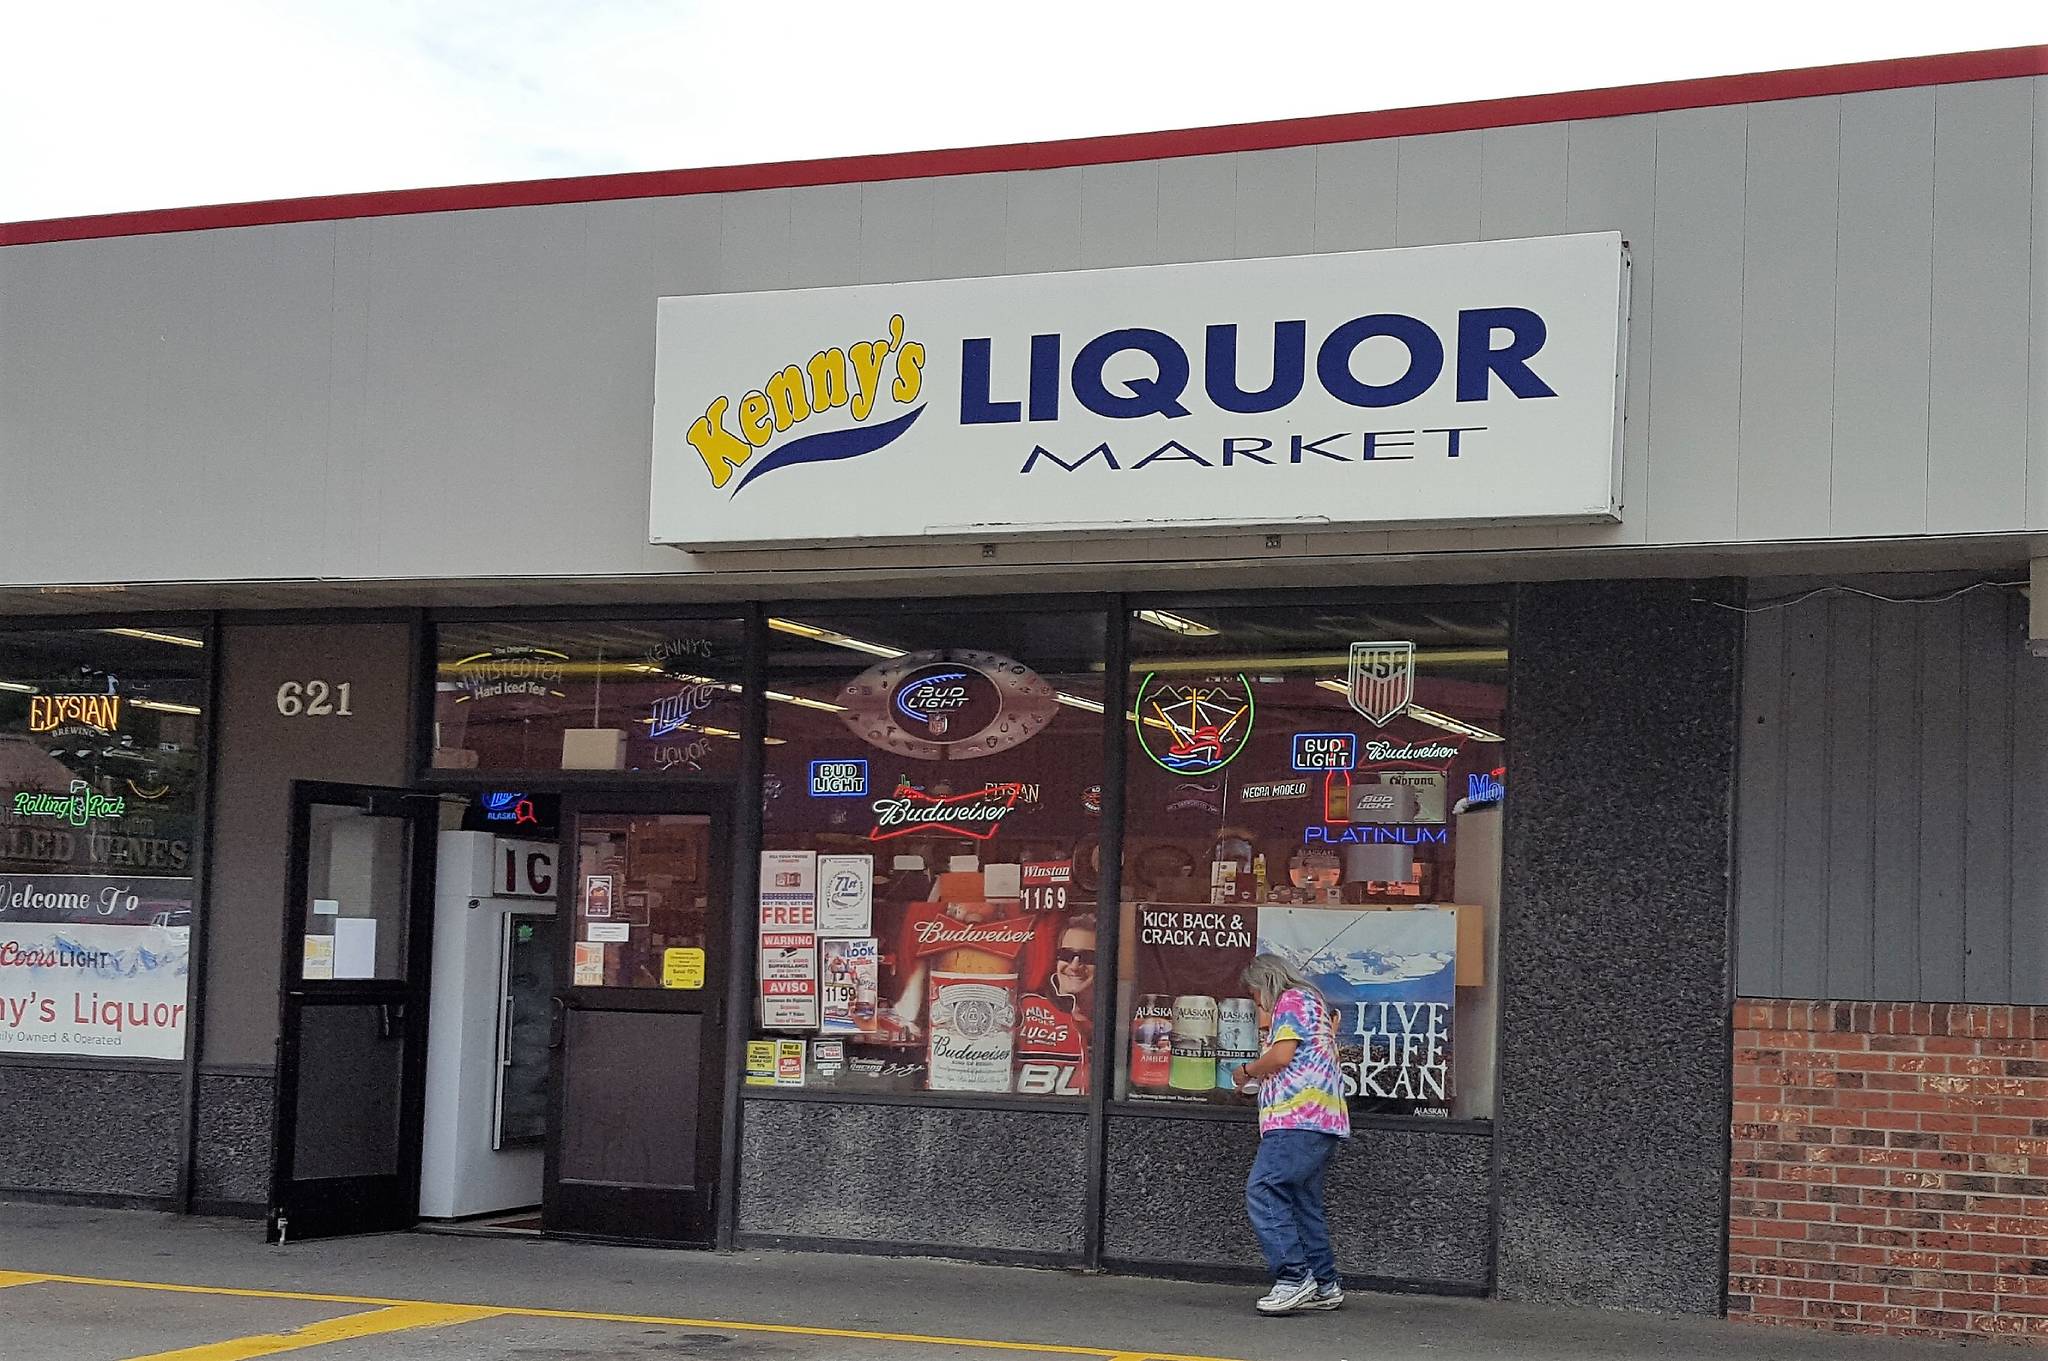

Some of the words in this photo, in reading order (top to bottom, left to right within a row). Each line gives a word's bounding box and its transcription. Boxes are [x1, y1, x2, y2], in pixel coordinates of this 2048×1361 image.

[687, 314, 927, 488] Kenny's
[960, 307, 1559, 425] LIQUOR
[1020, 426, 1488, 474] MARKET
[1360, 650, 1408, 679] USA
[277, 680, 353, 716] 621
[474, 682, 502, 700] Hard
[504, 681, 527, 694] Iced
[528, 682, 547, 697] Tea
[917, 686, 965, 698] BUD
[908, 697, 969, 708] LIGHT
[30, 694, 119, 731] ELYSIAN
[1304, 738, 1343, 752] BUD
[1366, 740, 1458, 761] Budweiser
[1296, 752, 1349, 767] LIGHT
[820, 763, 857, 779] BUD
[813, 777, 865, 793] LIGHT
[1390, 775, 1435, 787] Corona
[1468, 773, 1504, 802] Mo
[1242, 784, 1271, 799] NEGRA
[1272, 782, 1307, 797] MODELO
[1362, 795, 1393, 803] BUD
[14, 792, 70, 818] Rolling
[90, 793, 125, 817] Rock
[872, 798, 1014, 826] Budweiser
[1356, 802, 1395, 810] LIGHT
[487, 812, 517, 820] ALASKA
[1304, 826, 1447, 845] PLATINUM
[505, 847, 552, 894] IC
[1023, 865, 1070, 879] Winston
[97, 886, 139, 915] To
[762, 907, 814, 925] FREE
[1143, 911, 1178, 928] KICK
[1183, 913, 1226, 930] BACK
[1230, 914, 1244, 930] &
[763, 935, 813, 946] WARNING
[914, 921, 1036, 944] Budweiser
[1141, 929, 1194, 945] CRACK
[1198, 930, 1210, 946] A
[1215, 931, 1250, 948] CAN
[0, 940, 58, 968] Coors
[60, 950, 108, 969] LIGHT
[846, 946, 875, 957] LOOK
[769, 982, 808, 993] AVISO
[74, 992, 184, 1032] Liquor
[1176, 1007, 1216, 1023] ALASKAN
[1218, 1010, 1256, 1025] ALASKAN
[1354, 1001, 1449, 1037] LIVE
[0, 1031, 14, 1043] ily
[17, 1031, 56, 1043] Owned
[61, 1032, 70, 1043] &
[74, 1034, 122, 1046] Operated
[1020, 1025, 1068, 1042] LUCAS
[933, 1034, 1010, 1060] Budweiser
[1357, 1033, 1447, 1068] LIFE
[1140, 1055, 1169, 1063] AMBER
[1413, 1106, 1449, 1118] ALASKAN
